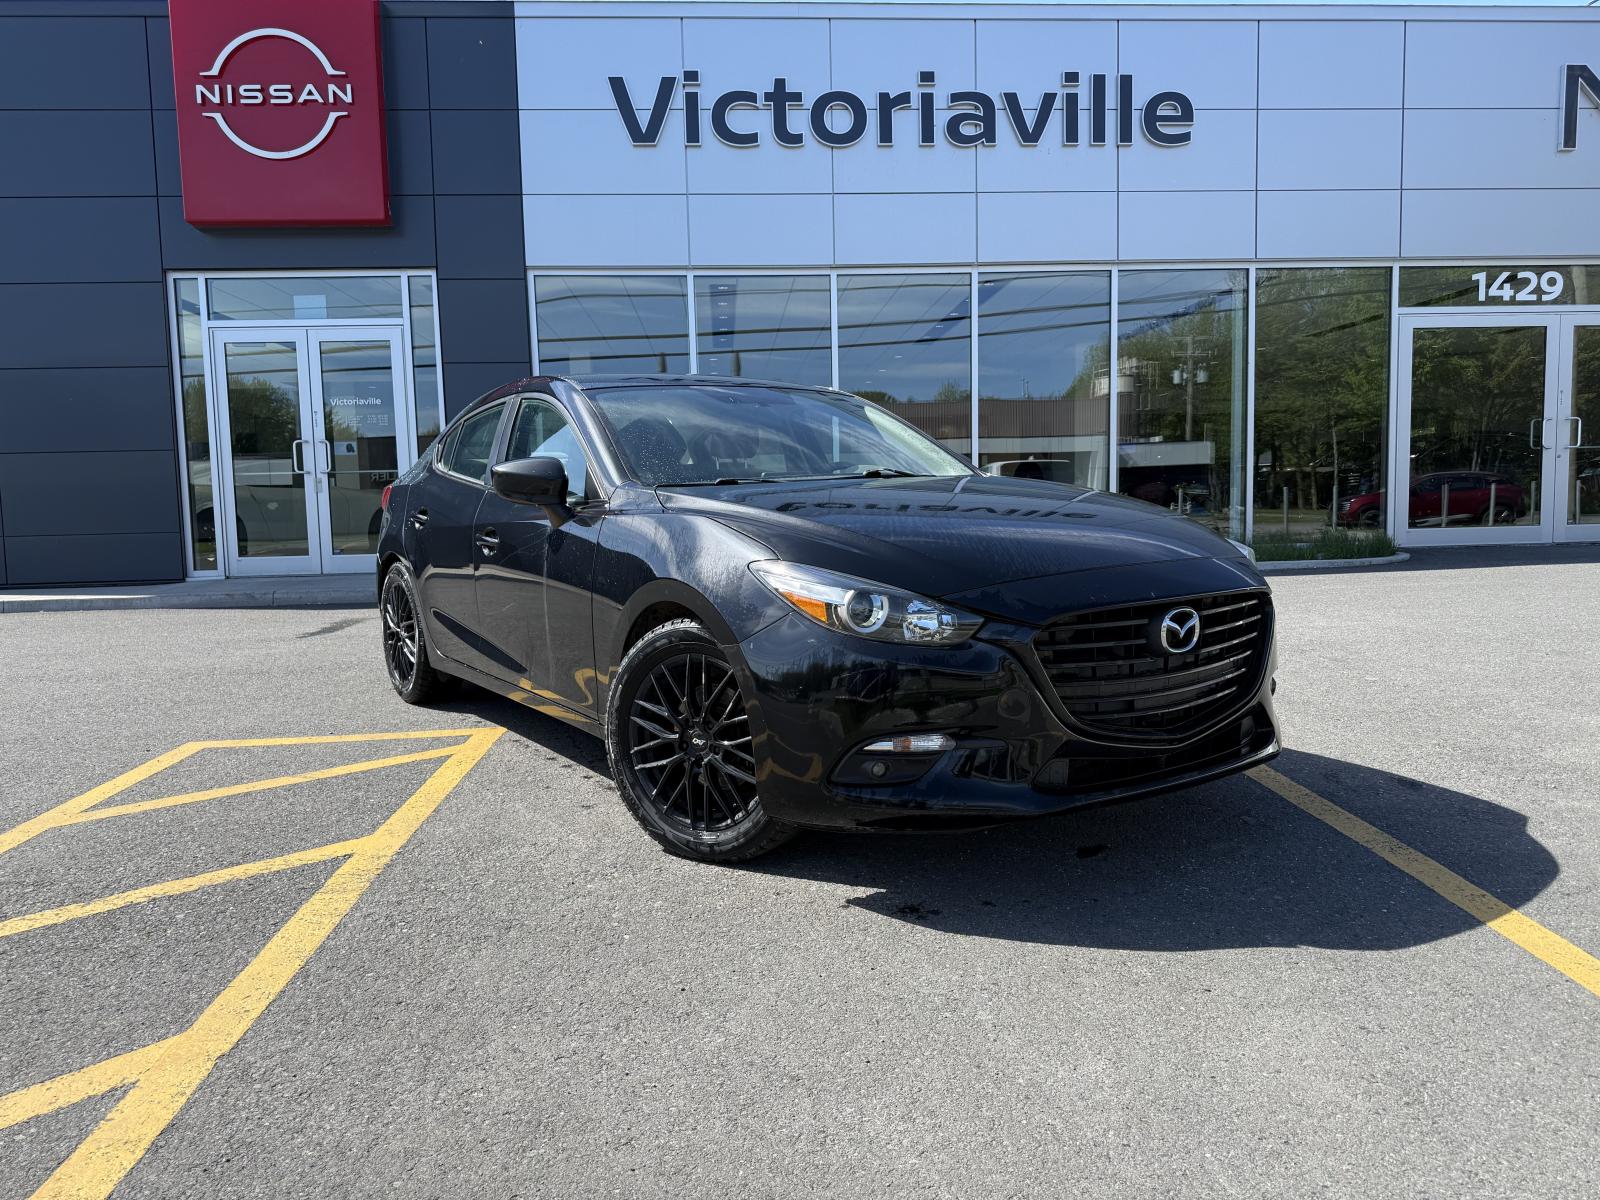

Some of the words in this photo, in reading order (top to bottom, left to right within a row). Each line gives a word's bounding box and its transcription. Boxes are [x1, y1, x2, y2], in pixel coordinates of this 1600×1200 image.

[195, 83, 353, 104] NISSAN
[607, 70, 1194, 148] Victoriaville
[1471, 270, 1564, 302] 1429
[330, 397, 382, 406] Victoriaville
